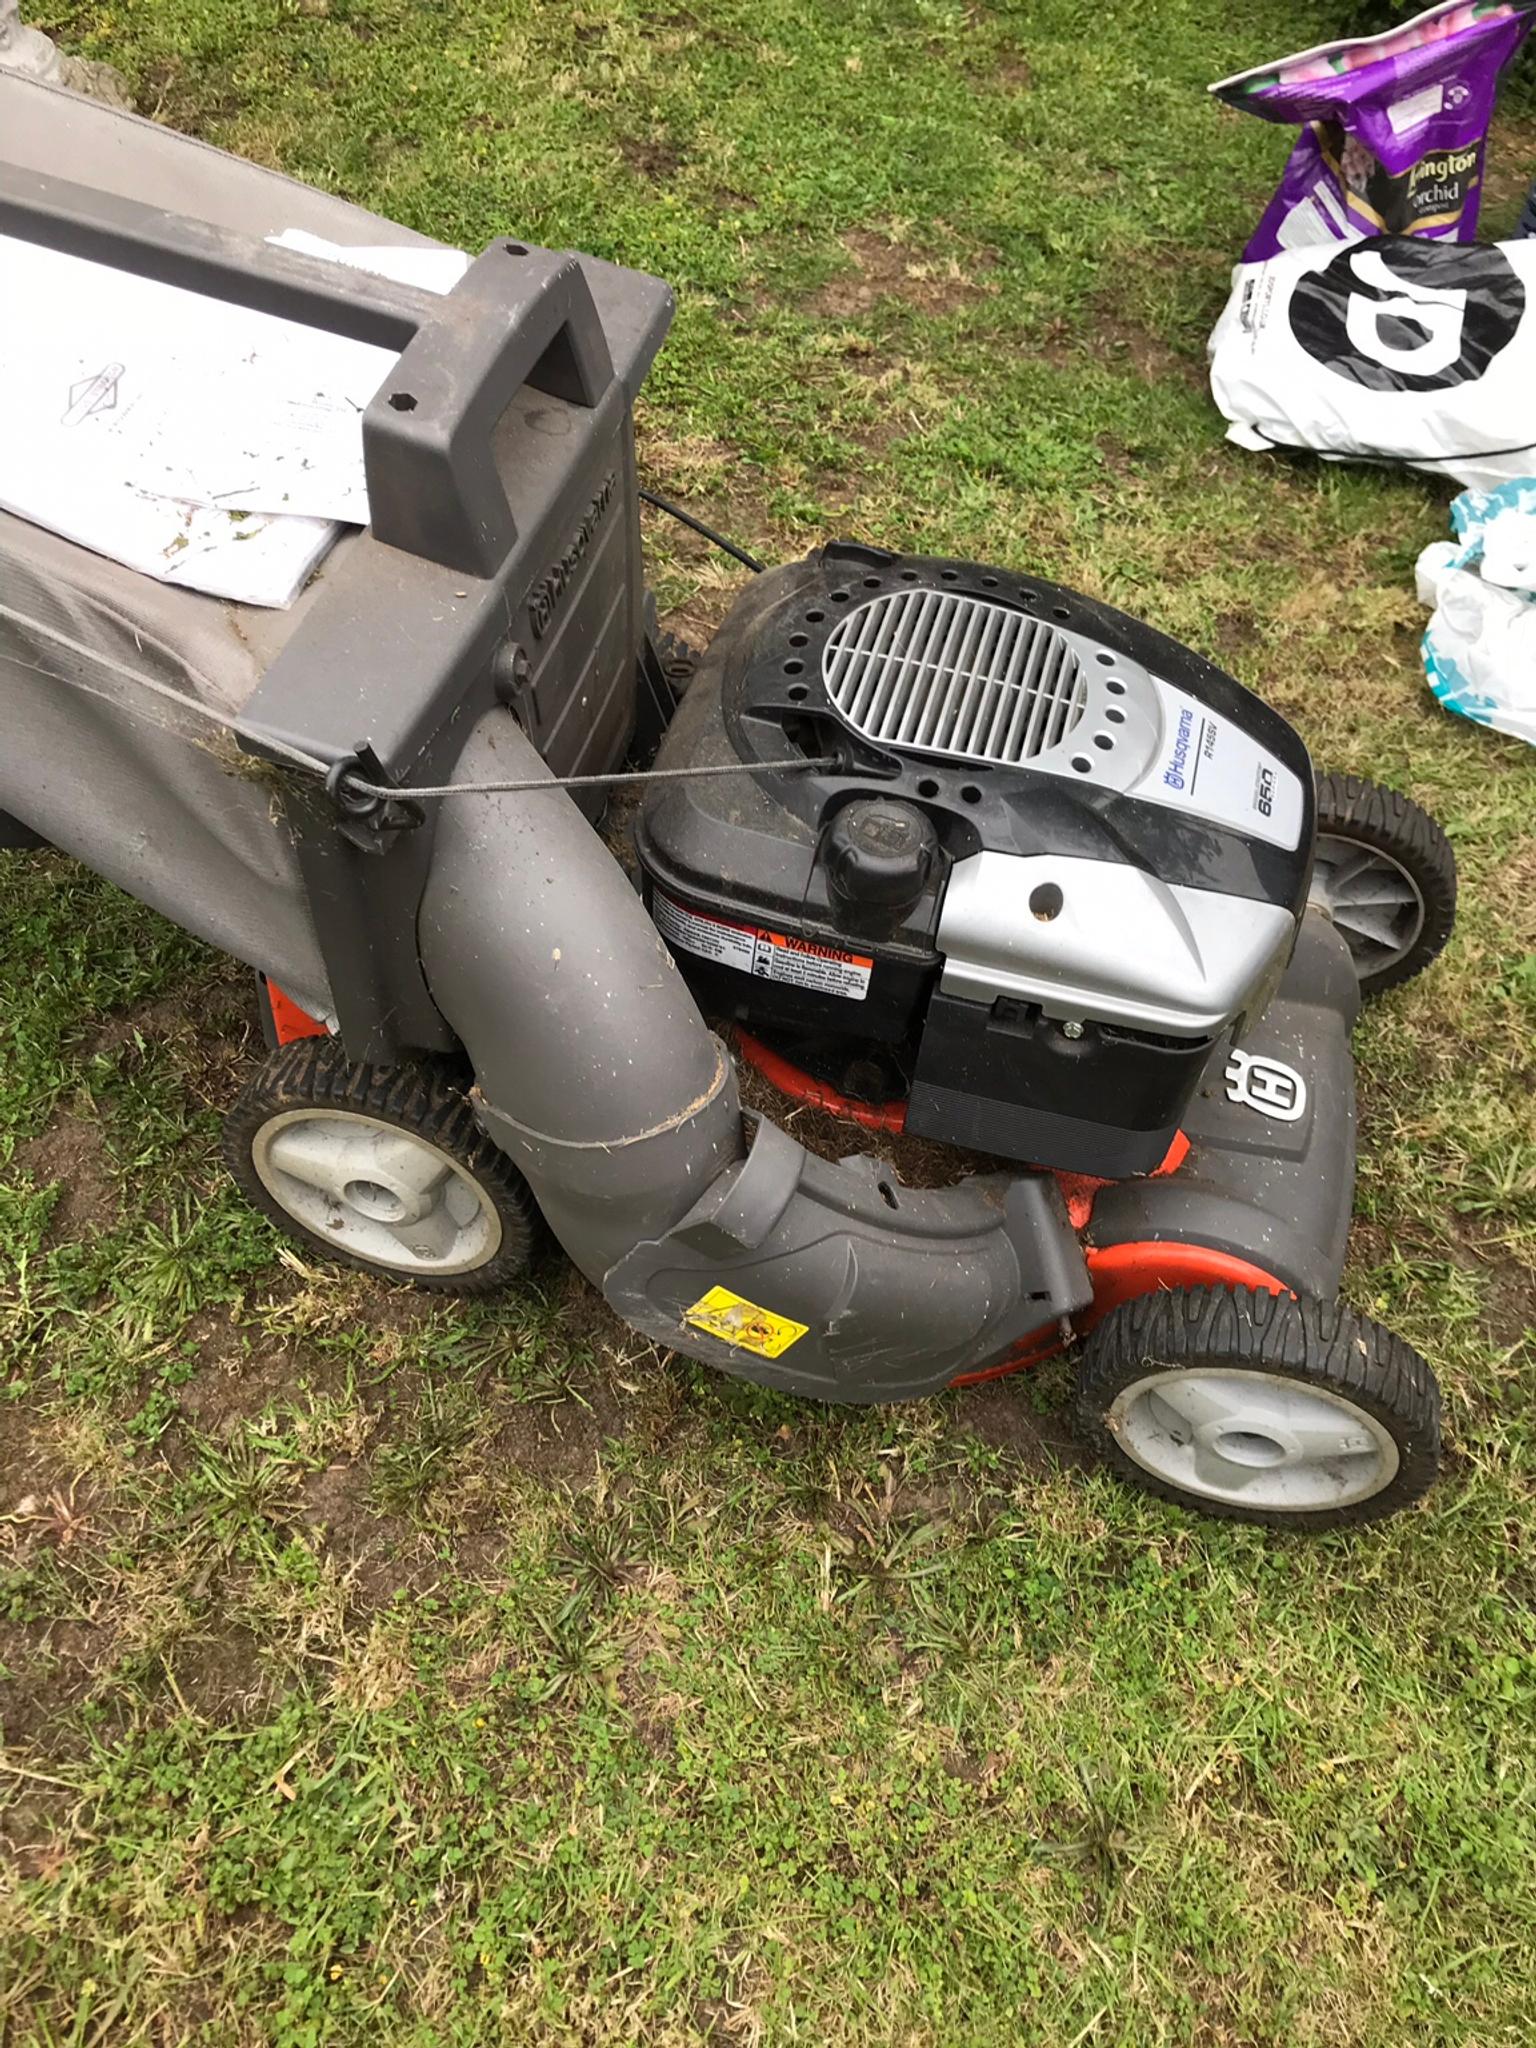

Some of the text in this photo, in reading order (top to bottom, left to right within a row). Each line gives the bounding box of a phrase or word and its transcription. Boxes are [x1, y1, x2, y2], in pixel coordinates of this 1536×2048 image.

[1407, 151, 1476, 199] Lington
[1168, 708, 1194, 776] Husqvarna
[1258, 767, 1273, 817] 650
[784, 937, 853, 963] WARNING
